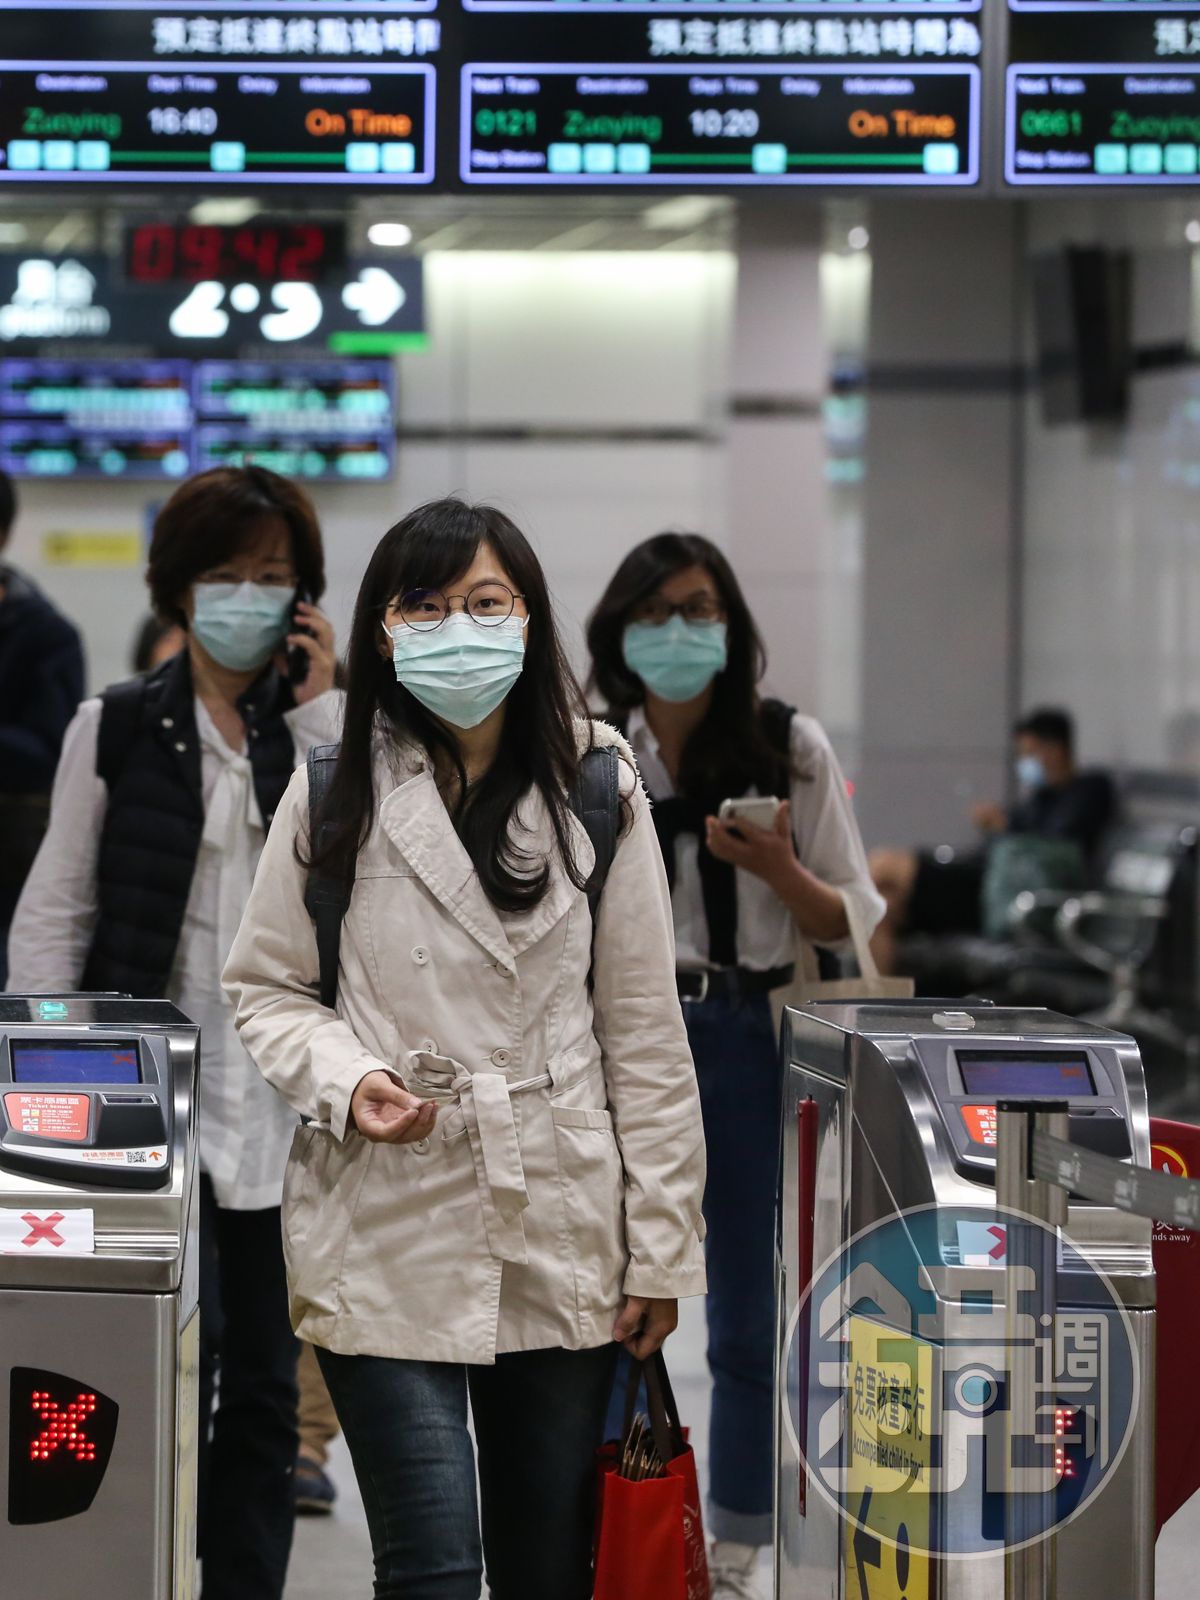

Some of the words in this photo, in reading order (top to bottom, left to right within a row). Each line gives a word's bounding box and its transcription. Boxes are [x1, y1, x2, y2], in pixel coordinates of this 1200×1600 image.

[305, 109, 345, 136] On
[349, 109, 412, 137] Time
[848, 110, 888, 137] On
[893, 109, 956, 138] Time
[853, 1431, 888, 1467] Accompanied
